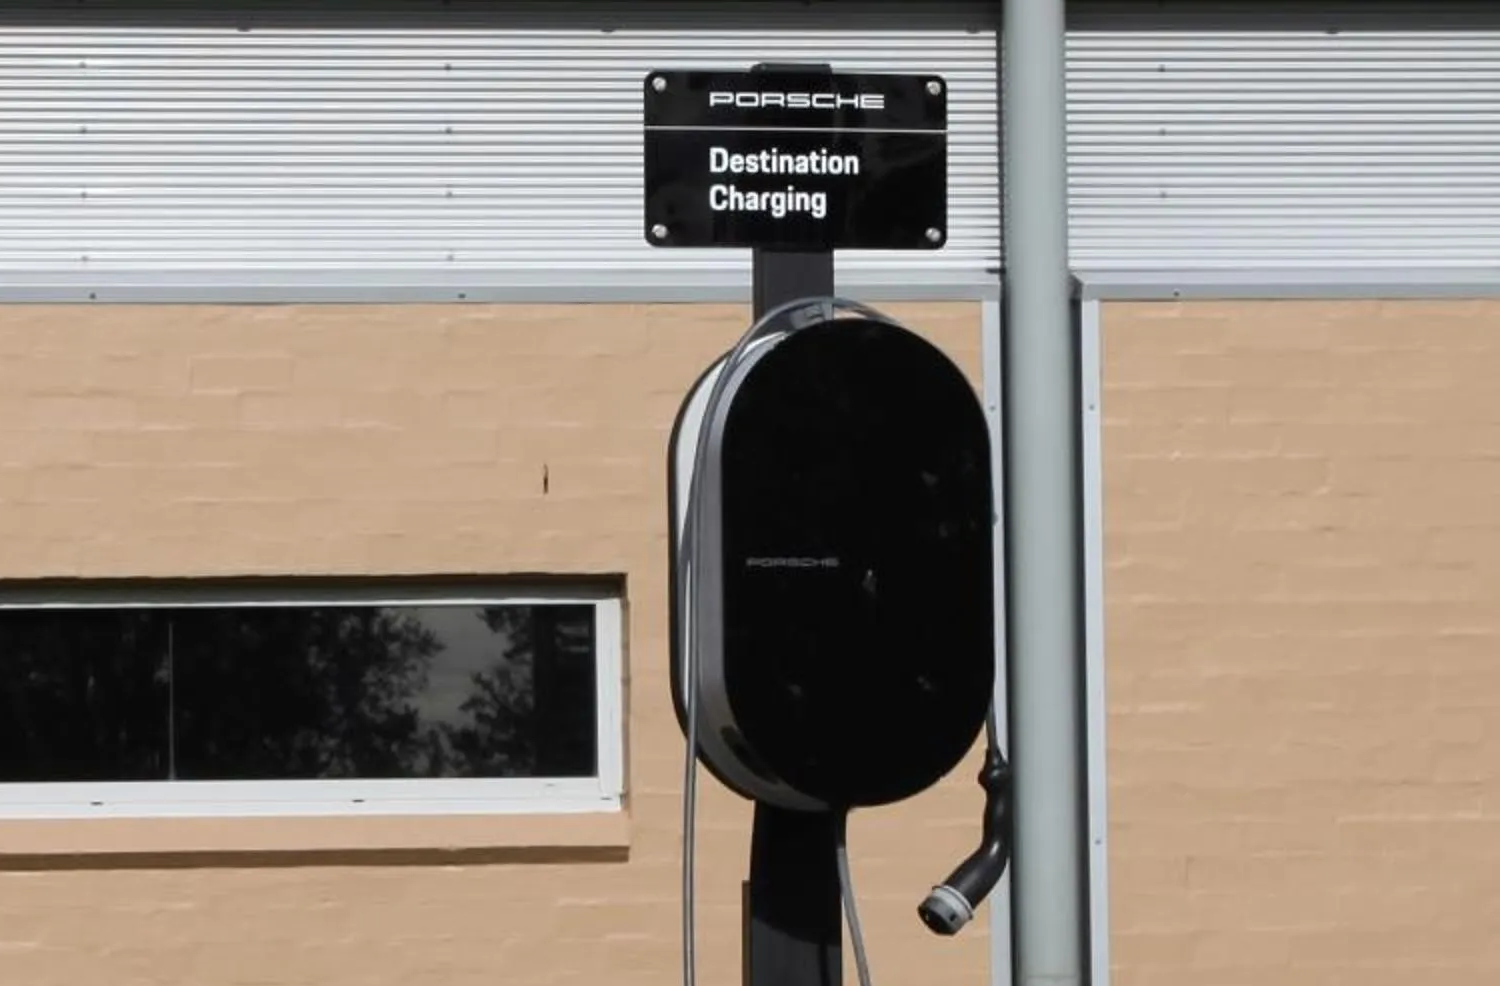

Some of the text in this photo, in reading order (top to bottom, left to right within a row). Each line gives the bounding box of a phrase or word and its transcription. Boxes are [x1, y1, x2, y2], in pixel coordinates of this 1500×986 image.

[709, 92, 885, 109] PORSCHE
[709, 147, 859, 175] Destination
[709, 184, 827, 218] Charging
[746, 557, 839, 568] PORSCHE
